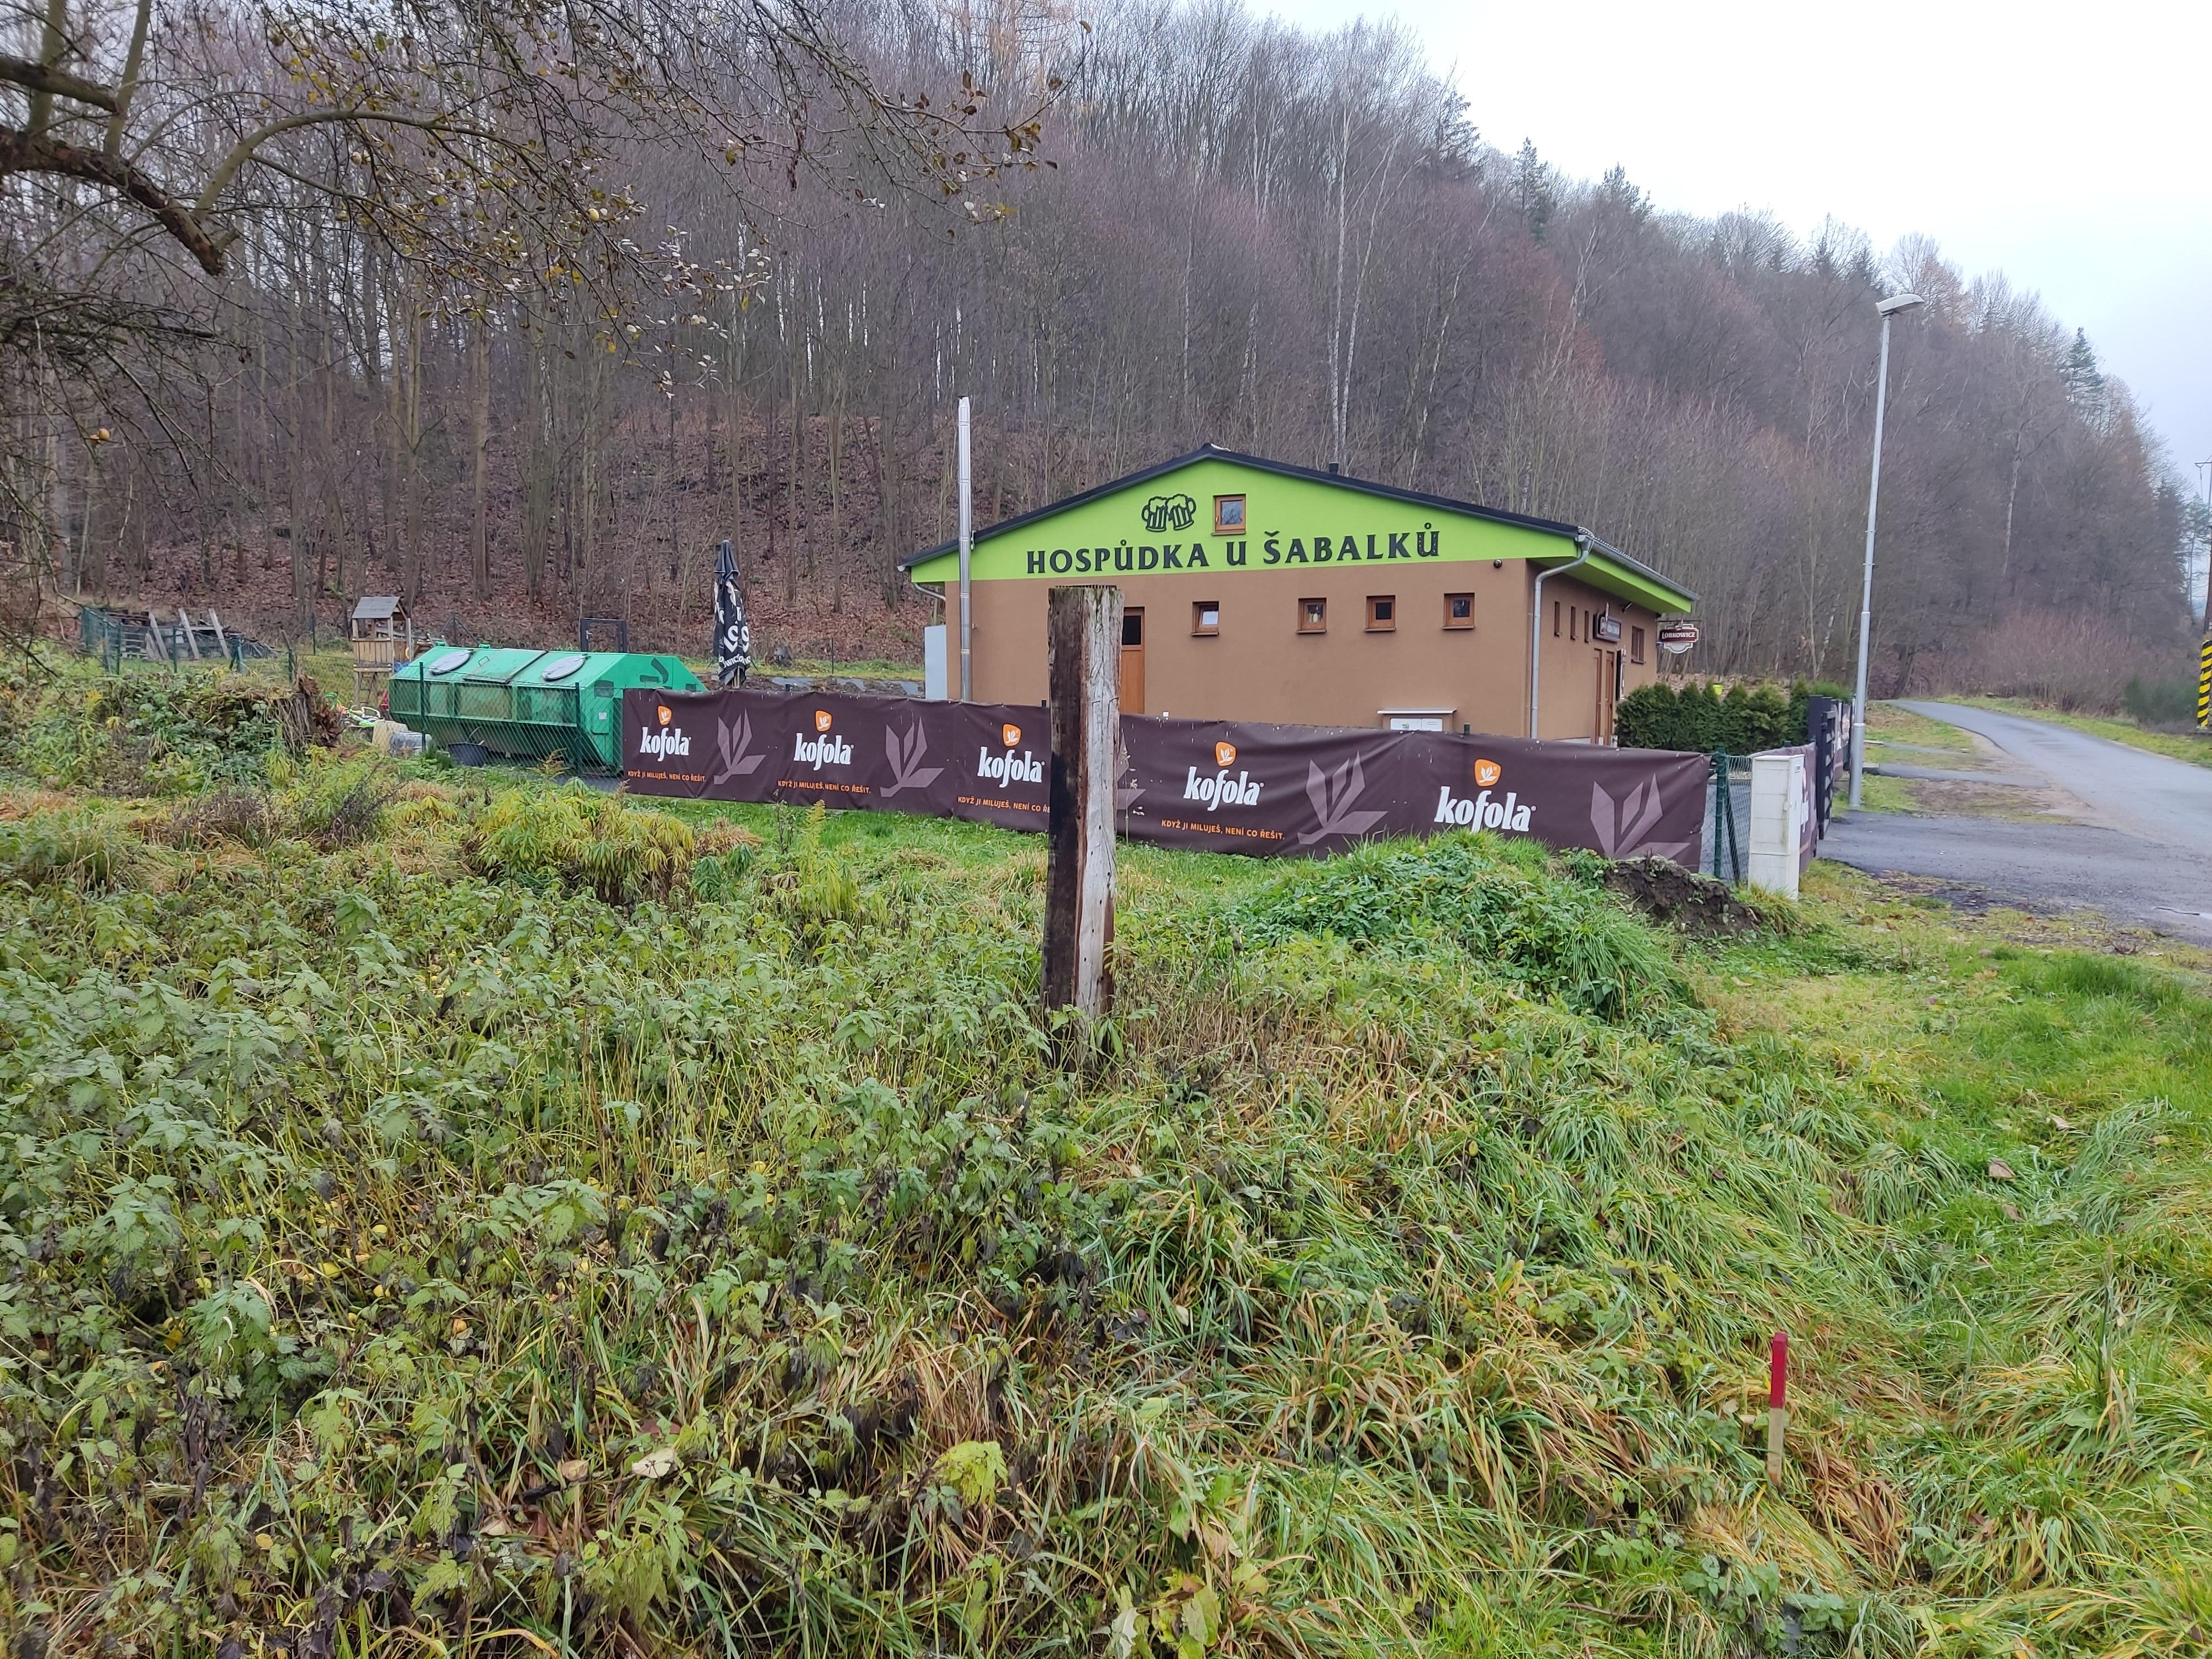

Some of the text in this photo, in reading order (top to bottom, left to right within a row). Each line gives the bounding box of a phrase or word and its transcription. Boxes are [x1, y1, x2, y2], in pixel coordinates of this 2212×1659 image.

[1026, 523, 1440, 574] HOSPŮDKA U ŠABALKŮ
[639, 727, 690, 762] kofola
[794, 733, 851, 770] kofola
[793, 781, 798, 789] JI
[977, 747, 1042, 788] kofola
[958, 796, 974, 804] KDYŽ
[1013, 802, 1029, 811] NENÍ
[1183, 766, 1260, 811] kofola
[1161, 820, 1181, 829] KDYŽ
[1225, 827, 1244, 836] NENÍ
[1434, 786, 1531, 834] kofola
